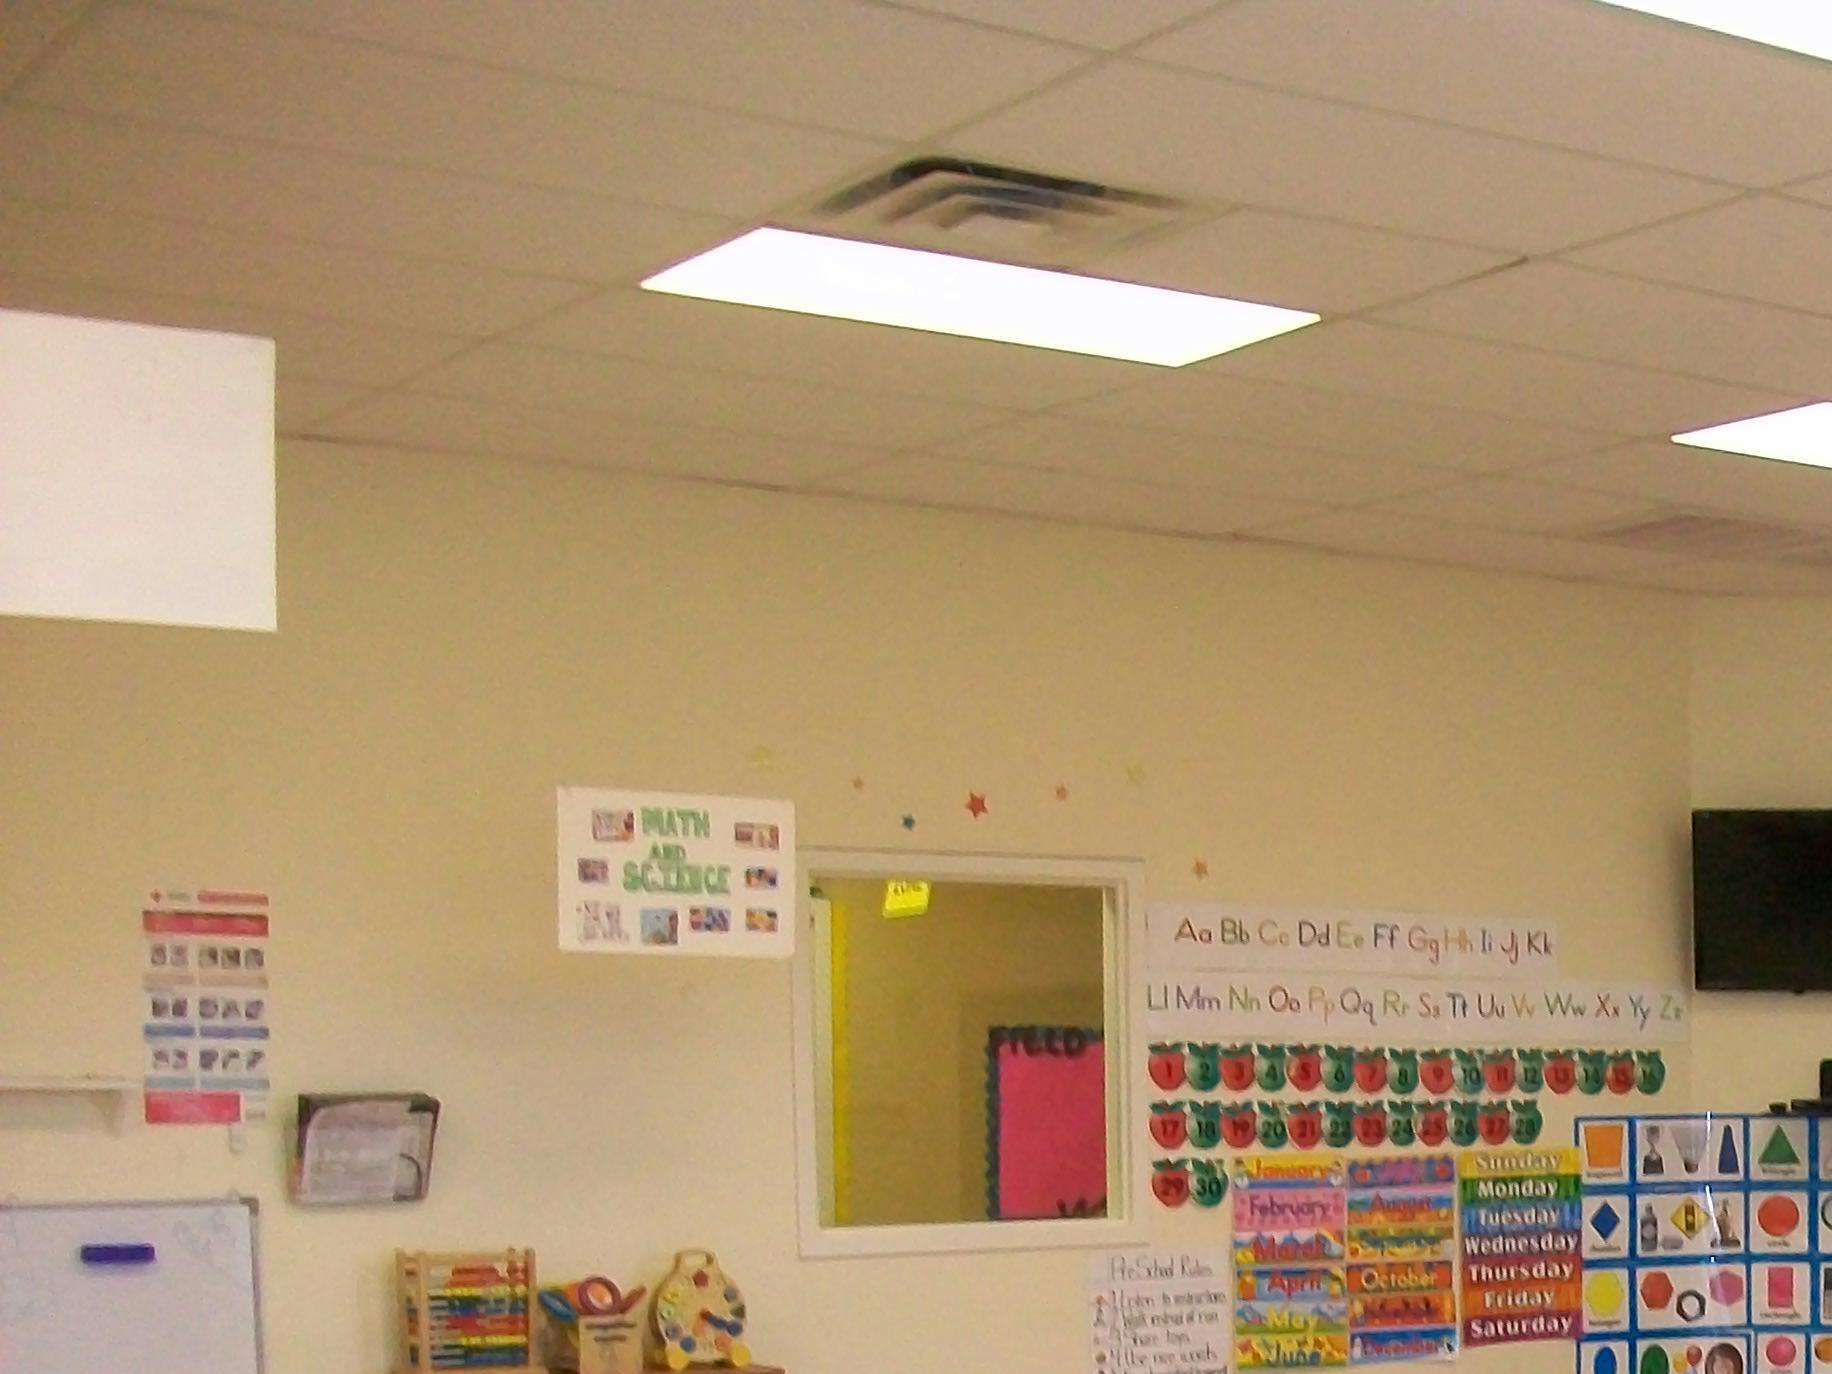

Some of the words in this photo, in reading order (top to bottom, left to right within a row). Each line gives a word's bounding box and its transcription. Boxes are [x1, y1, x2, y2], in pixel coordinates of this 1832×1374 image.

[641, 806, 710, 838] MATH
[652, 843, 686, 860] AND
[622, 860, 731, 895] SCIENCE
[1174, 917, 1212, 945] Aa
[1220, 917, 1250, 946] Bb
[1258, 919, 1290, 946] Cc
[1298, 920, 1331, 947] Dd
[1337, 921, 1364, 948] Ee
[1373, 923, 1400, 949] Ff
[1408, 925, 1440, 965] Gg
[1444, 927, 1474, 953] Hh
[1526, 930, 1553, 956] Kk
[1175, 984, 1221, 1012] Mm
[1228, 984, 1261, 1012] Nn
[1268, 985, 1301, 1013] Oo
[1308, 986, 1335, 1026] Pp
[1339, 987, 1378, 1027] Qq
[1383, 989, 1410, 1016] Rr
[1418, 992, 1441, 1018] Ss
[1446, 992, 1468, 1019] Tt
[1477, 993, 1505, 1019] Uu
[1511, 992, 1536, 1019] Vv
[1543, 992, 1587, 1019] Ww
[1595, 994, 1620, 1019] Xx
[1628, 994, 1651, 1031] Yy
[1254, 1157, 1327, 1179] January
[1475, 1152, 1560, 1171] Sunday
[1195, 1180, 1222, 1198] 30
[1477, 1178, 1558, 1198] Monday
[1250, 1194, 1331, 1221] February
[1479, 1207, 1559, 1226] Tuesday
[1253, 1232, 1325, 1259] March
[1465, 1232, 1578, 1255] Wednesday
[1268, 1267, 1322, 1297] April
[1361, 1267, 1438, 1290] October
[1469, 1261, 1574, 1284] Thursday
[1485, 1289, 1554, 1309] Friday
[1267, 1303, 1319, 1333] May
[1470, 1315, 1572, 1338] Saturday
[1267, 1343, 1322, 1366] June
